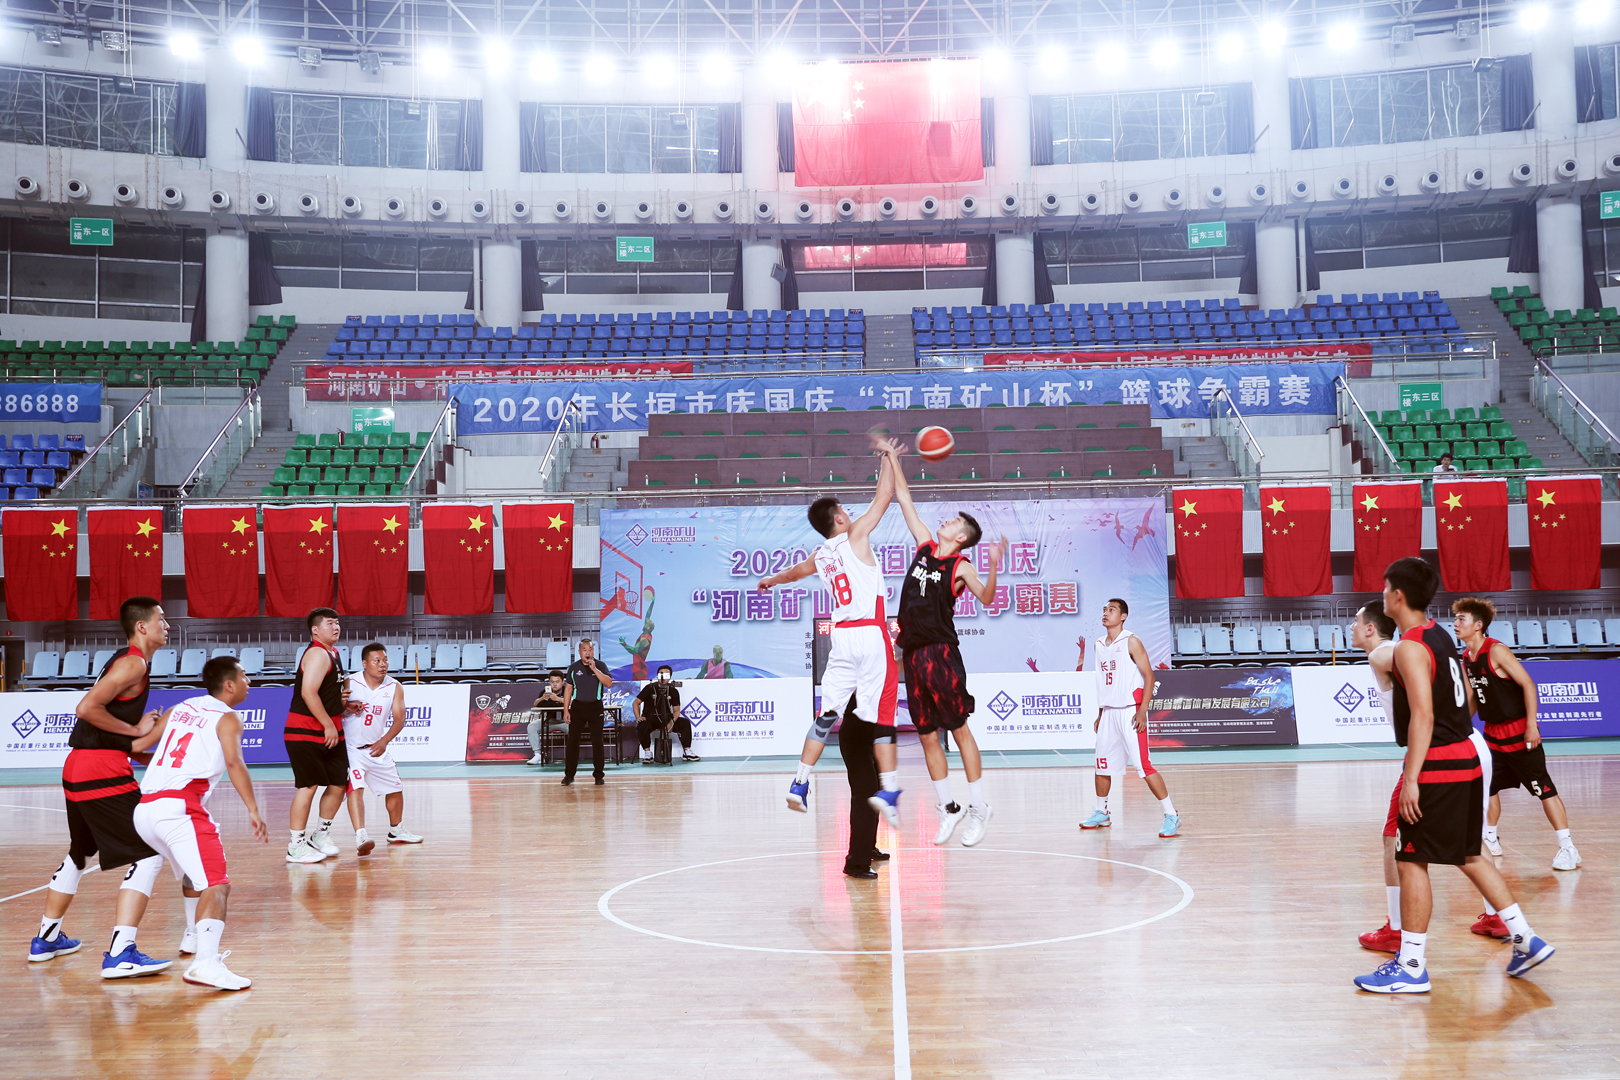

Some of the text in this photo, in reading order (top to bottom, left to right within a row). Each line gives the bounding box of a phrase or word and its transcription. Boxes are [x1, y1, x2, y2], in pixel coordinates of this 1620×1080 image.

[83, 227, 110, 236] 东一区
[1412, 392, 1440, 402] 东三区
[0, 394, 79, 413] 86888
[652, 526, 696, 537] 河南矿山
[830, 572, 852, 608] 18
[1449, 656, 1465, 707] 8
[1538, 682, 1598, 696] 河南矿山
[1022, 694, 1081, 707] 河南矿山
[1477, 689, 1486, 704] 5
[1540, 696, 1599, 704] HENANMINE
[715, 701, 775, 714] 河南矿山
[1022, 708, 1081, 716] HENANMINE
[364, 714, 373, 726] 8
[715, 714, 775, 722] HENANMINE
[156, 728, 194, 768] 14
[1096, 758, 1108, 770] 15
[352, 769, 362, 780] 8
[1531, 780, 1542, 796] 5
